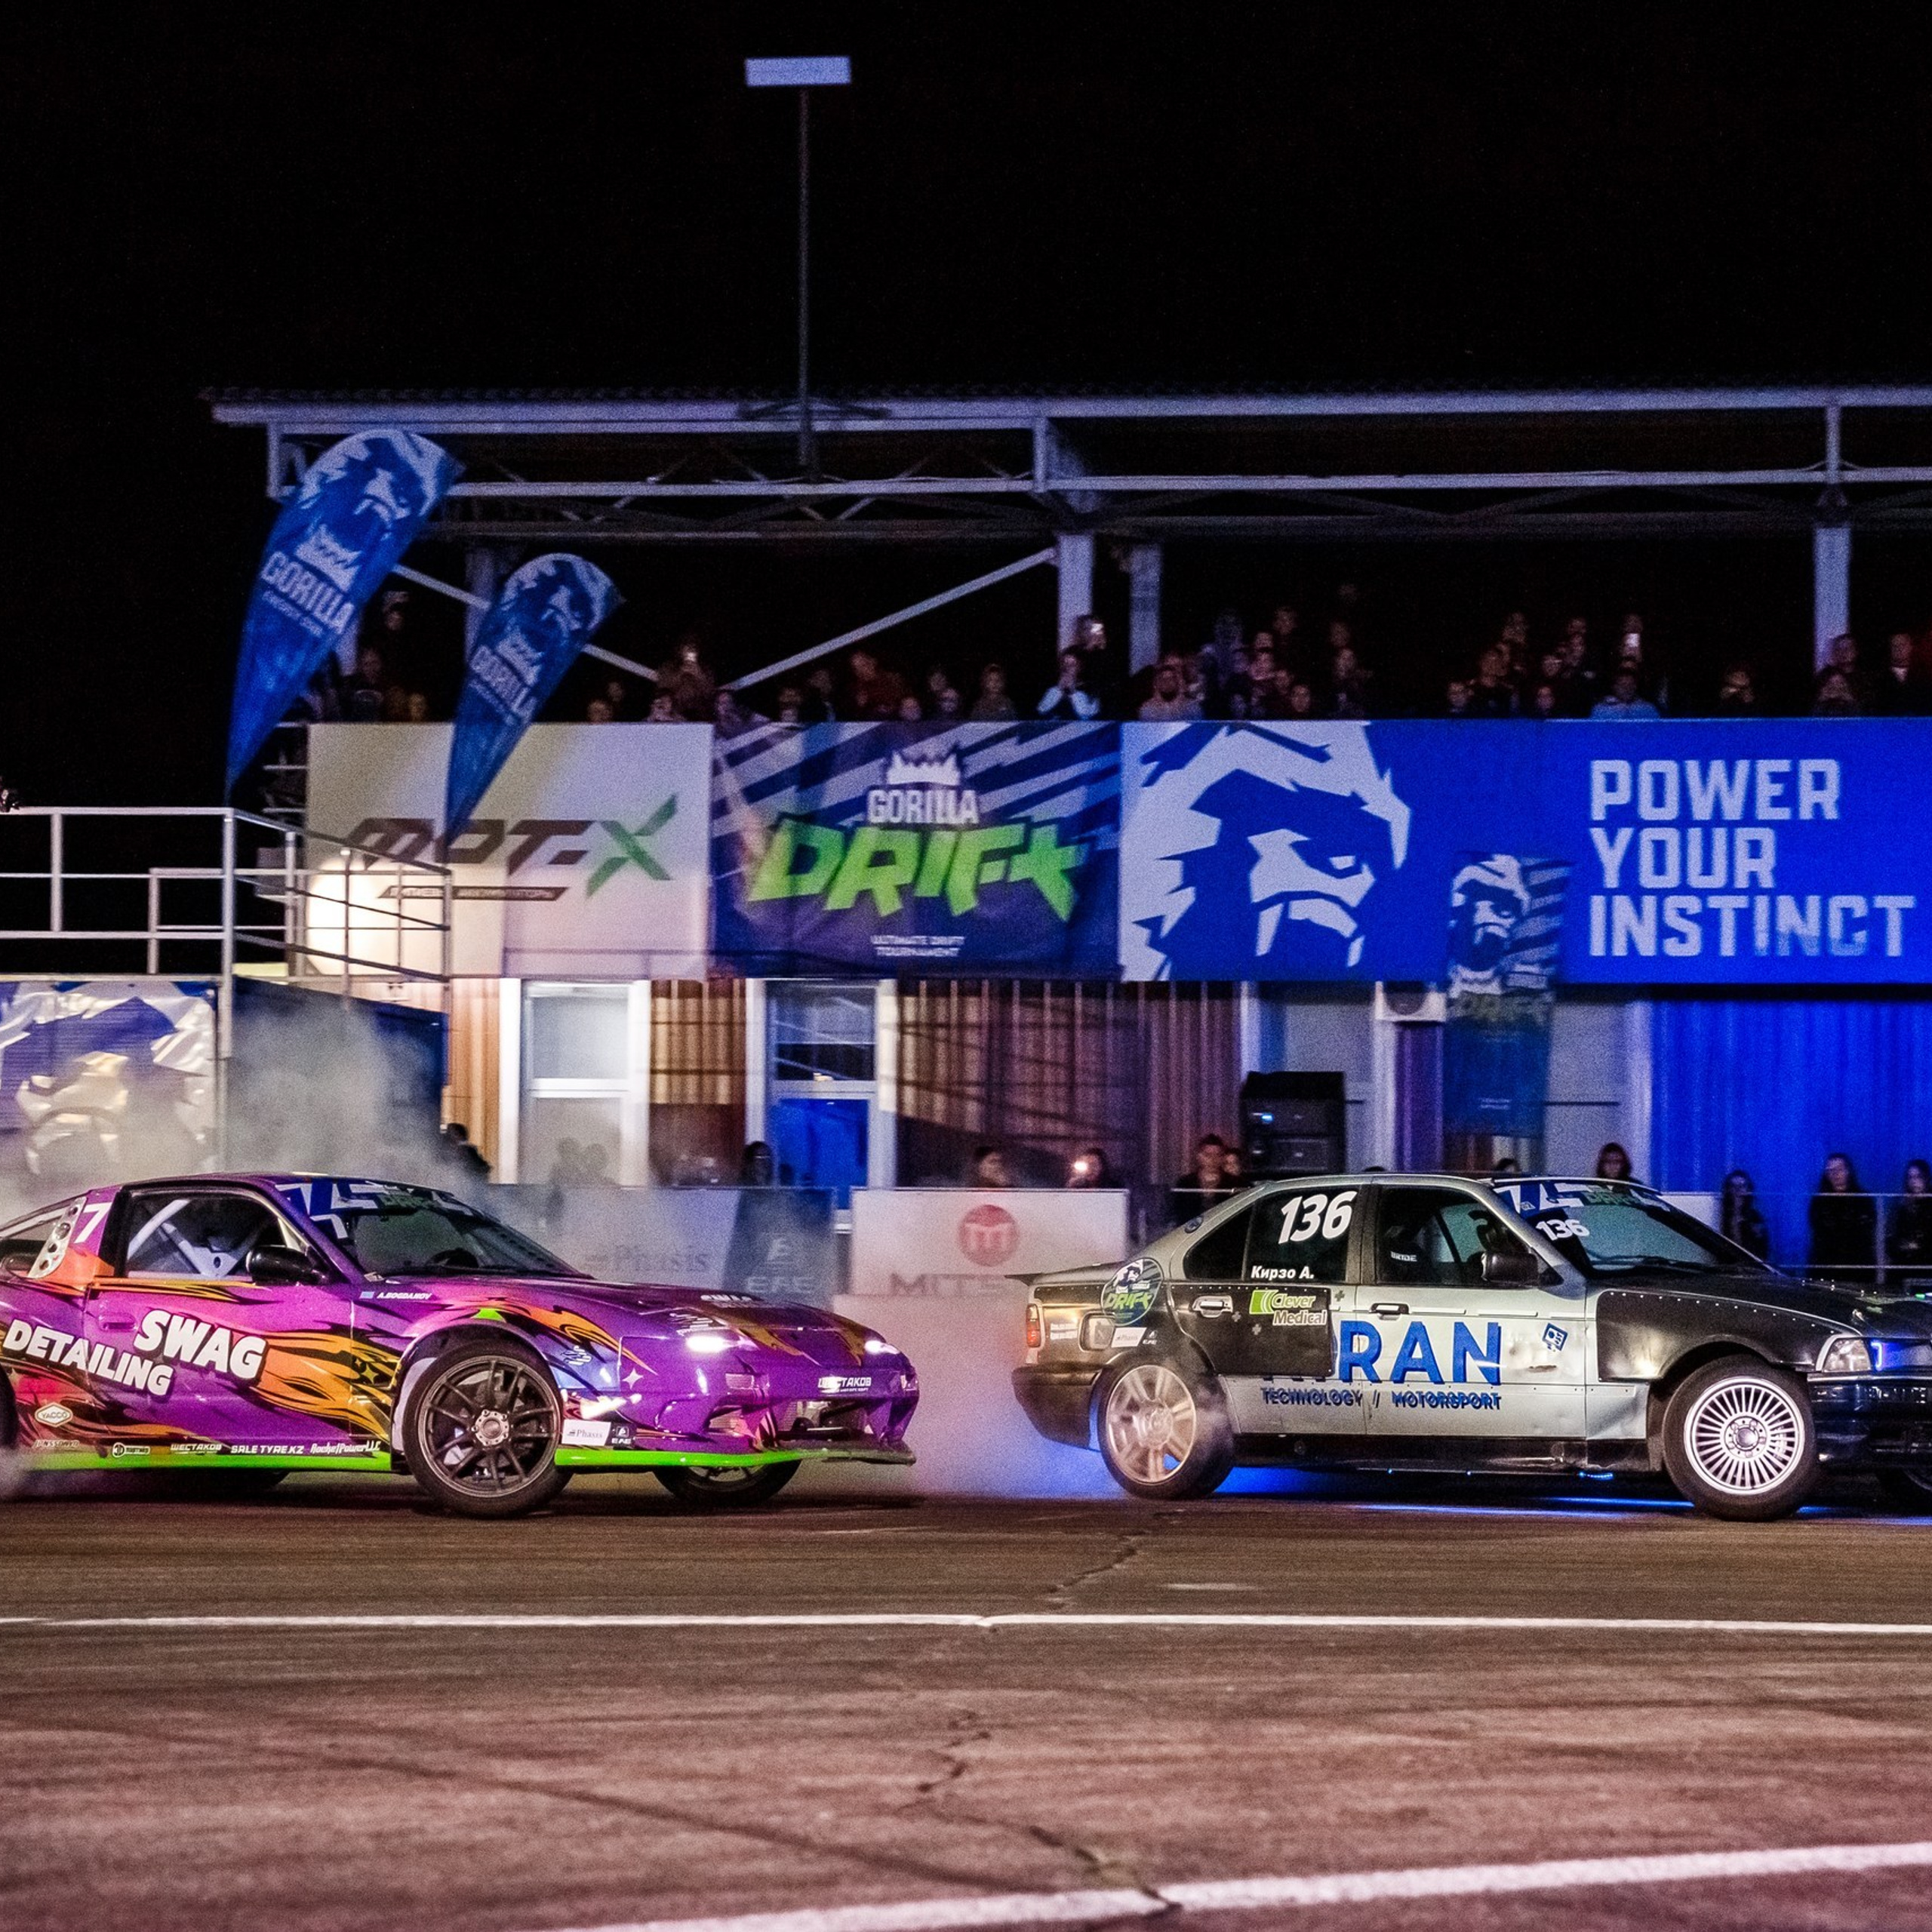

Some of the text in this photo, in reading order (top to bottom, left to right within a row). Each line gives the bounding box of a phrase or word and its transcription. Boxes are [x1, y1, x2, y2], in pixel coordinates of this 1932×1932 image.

[261, 551, 355, 635] GORILLA
[867, 789, 979, 824] GORILLA
[1590, 758, 1841, 821] POWER
[747, 819, 1088, 922] DRIFT
[1589, 827, 1776, 889] YOUR
[1589, 895, 1916, 957] INSTINCT
[74, 1202, 112, 1243] 7
[1278, 1191, 1358, 1244] 136
[1536, 1219, 1590, 1241] 136
[1251, 1265, 1297, 1281] Кирзо
[1103, 1292, 1152, 1310] DRIFT
[1272, 1294, 1316, 1309] Clever
[1272, 1309, 1327, 1326] Medical
[2, 1318, 174, 1396] DETAILING
[134, 1309, 267, 1380] SWAG
[1331, 1320, 1502, 1386] RAN
[818, 1377, 872, 1388] ШТАКОВ
[1261, 1387, 1363, 1407] TECHNOLOGY
[1391, 1389, 1502, 1410] MOTORSPORT
[41, 1410, 68, 1420] YACCO
[231, 1445, 257, 1454] SALE
